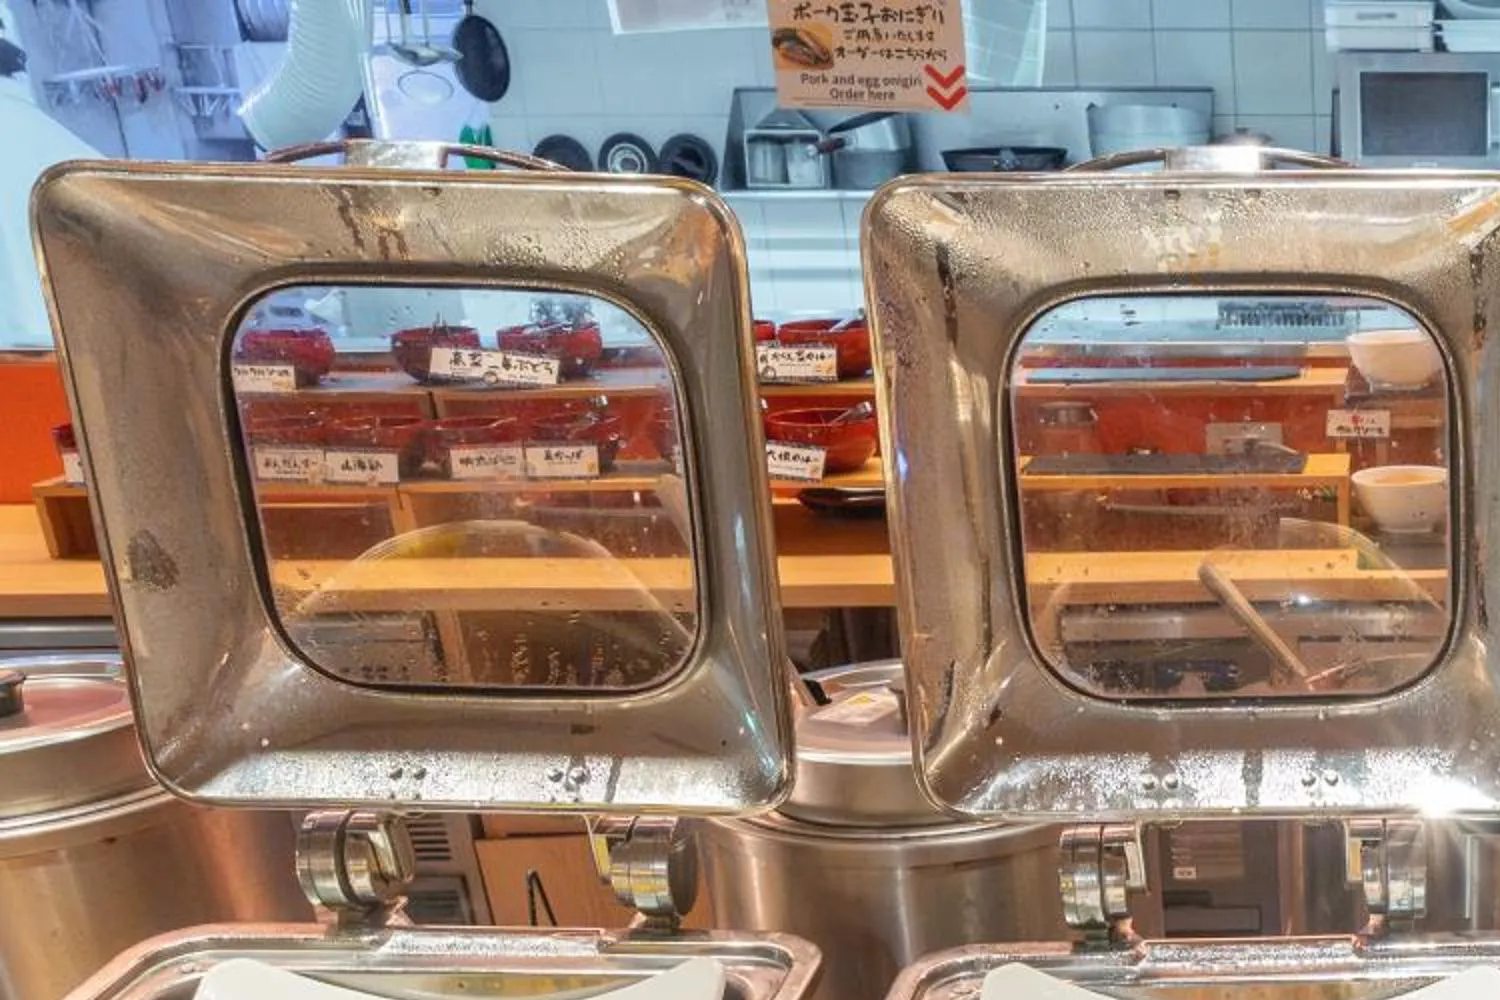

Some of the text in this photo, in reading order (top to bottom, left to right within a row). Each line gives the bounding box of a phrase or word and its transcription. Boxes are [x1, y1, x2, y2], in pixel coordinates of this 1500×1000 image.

[800, 72, 829, 85] Pork
[832, 73, 855, 85] and
[857, 75, 881, 89] egg
[829, 89, 897, 100] Order here
